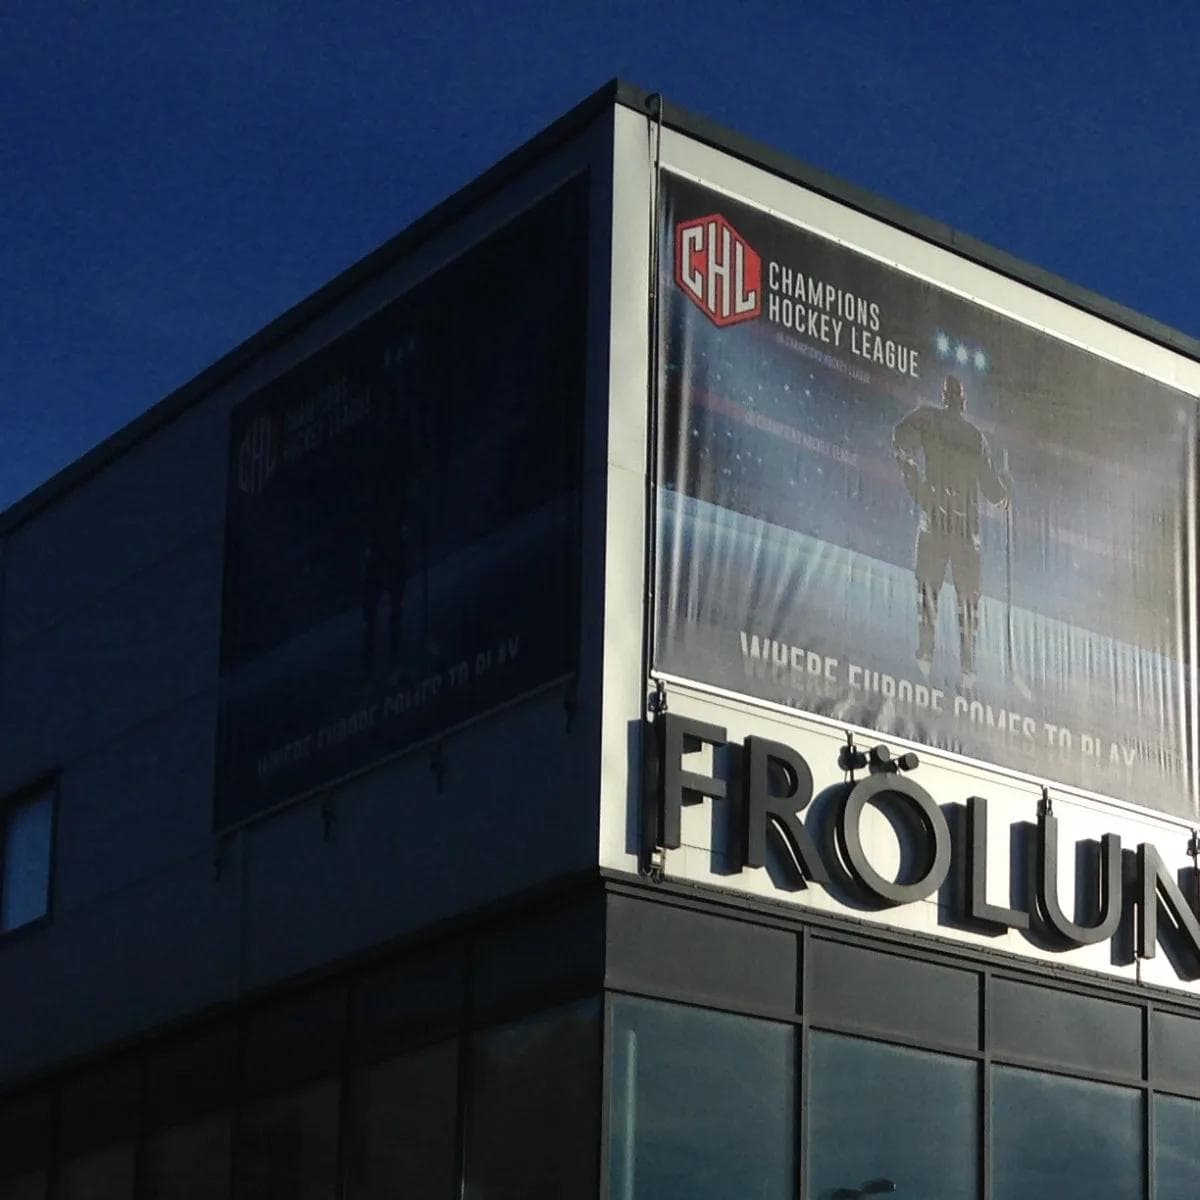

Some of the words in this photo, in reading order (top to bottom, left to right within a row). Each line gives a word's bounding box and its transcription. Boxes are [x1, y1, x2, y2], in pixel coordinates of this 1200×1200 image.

[681, 221, 756, 318] CHL
[768, 261, 880, 331] CHAMPIONS
[768, 293, 843, 346] HOCKEY
[851, 326, 920, 377] LEAGUE
[739, 631, 839, 682] WHERE
[848, 664, 944, 712] EUROPE
[953, 695, 1037, 739] COMES
[1044, 723, 1072, 751] TO
[1080, 734, 1138, 767] PLAY
